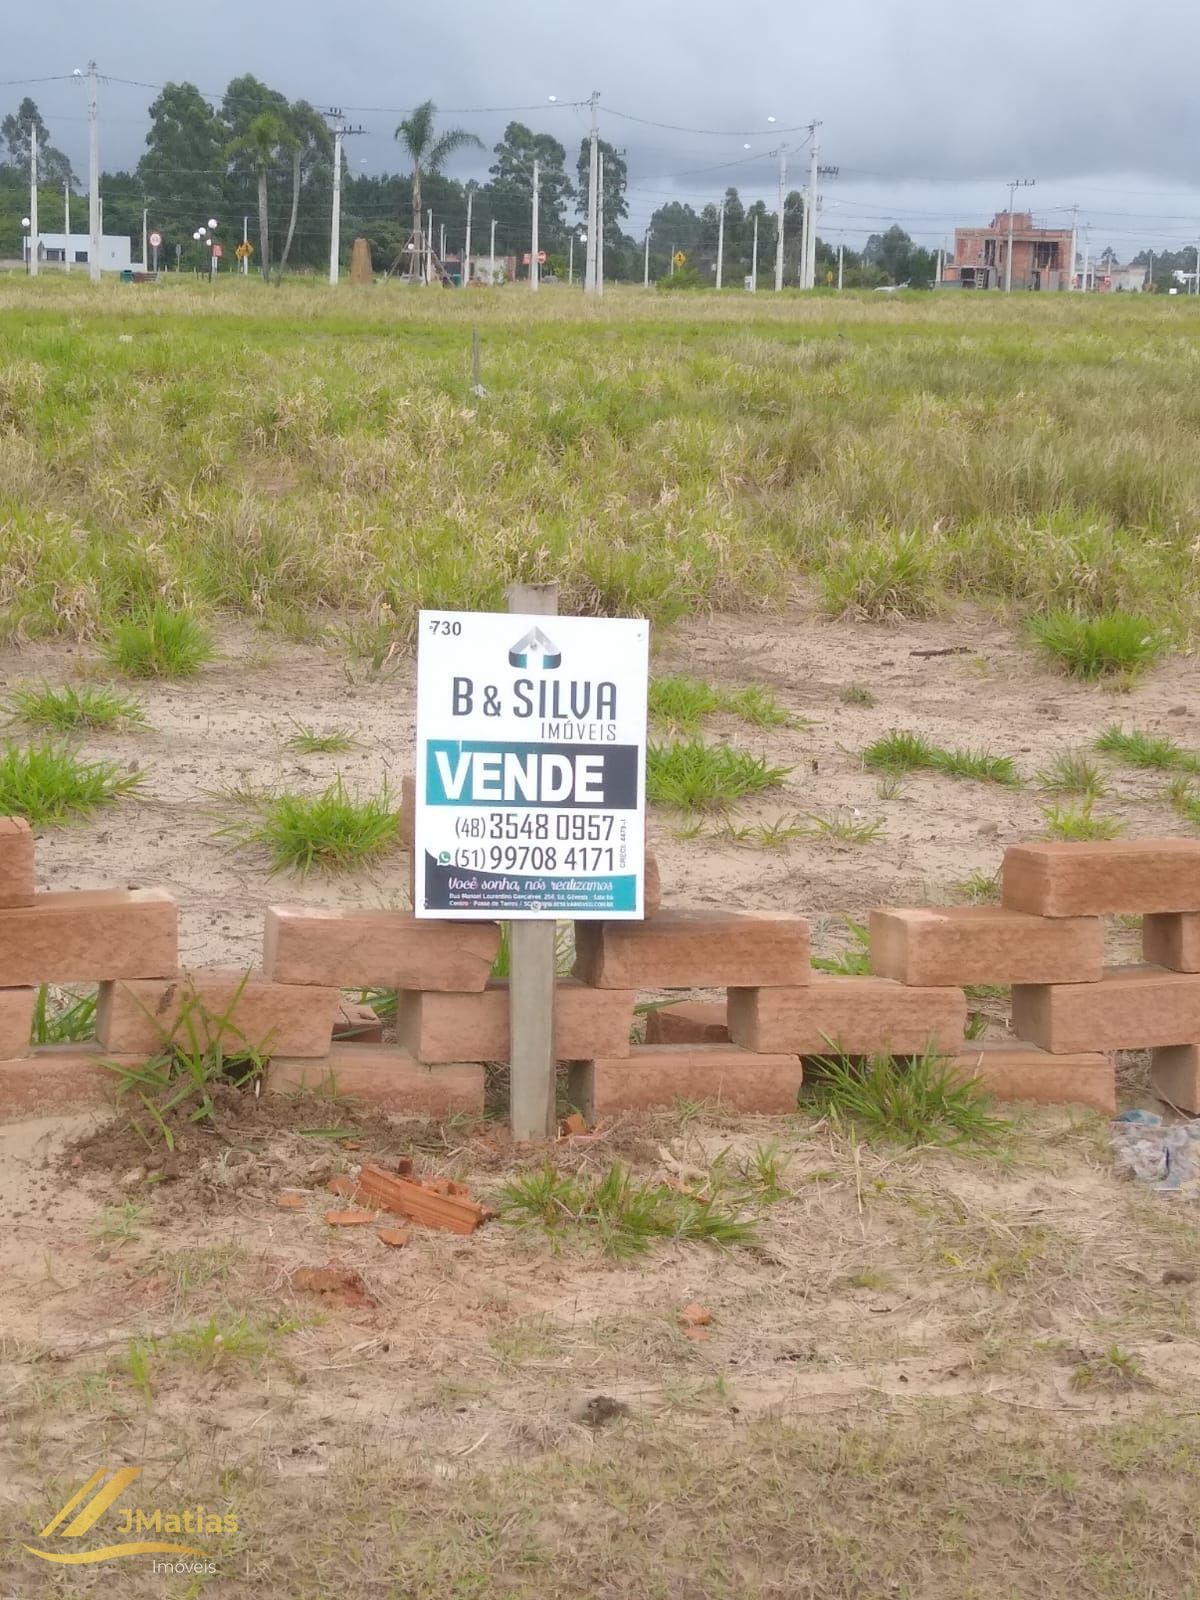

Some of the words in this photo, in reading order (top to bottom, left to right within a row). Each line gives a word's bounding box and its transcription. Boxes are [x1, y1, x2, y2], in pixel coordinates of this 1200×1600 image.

[430, 620, 462, 636] 730
[452, 677, 473, 716] B
[483, 685, 501, 717] &
[513, 679, 617, 720] SILVA
[541, 720, 616, 741] IMÓVEIS
[435, 751, 605, 803] VENDE
[455, 816, 486, 839] (48)
[490, 813, 548, 840] 3548
[556, 814, 615, 841] 0957
[455, 847, 486, 870] (51)
[490, 846, 557, 870] 99708
[564, 848, 614, 872] 4171
[448, 877, 478, 890] Você
[481, 877, 520, 892] sonha,
[525, 878, 545, 890] nós
[551, 878, 613, 891] realizamos
